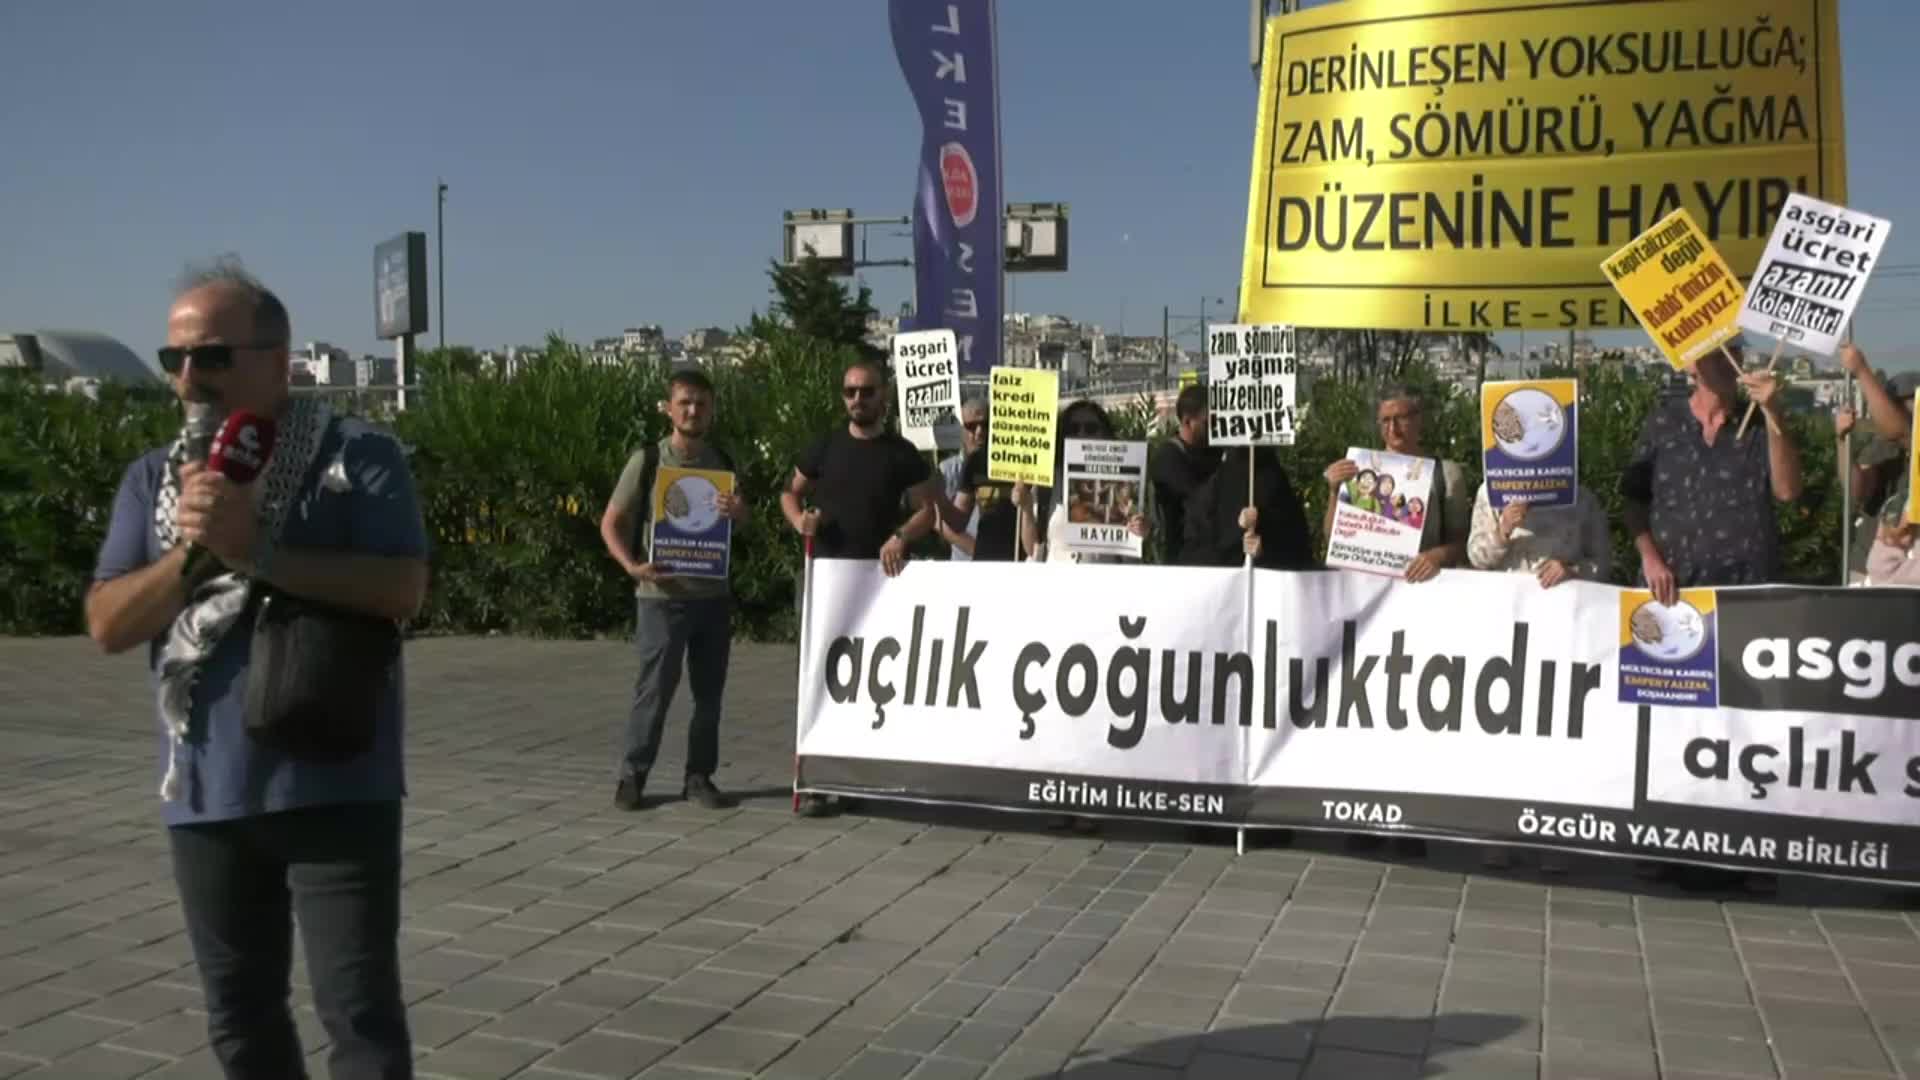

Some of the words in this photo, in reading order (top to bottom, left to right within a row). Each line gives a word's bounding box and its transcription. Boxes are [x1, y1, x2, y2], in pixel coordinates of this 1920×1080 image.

[1287, 41, 1507, 97] DERİNLEŞEN
[1522, 16, 1807, 79] YOKSULLUĞA;
[1280, 116, 1375, 167] ZAM,
[1389, 95, 1615, 157] SÖMÜRÜ,
[1634, 83, 1809, 148] YAĞMA
[1276, 174, 1574, 252] DÜZENİNE
[1786, 204, 1876, 243] asgari
[1608, 218, 1690, 280] kapitalizmin
[1661, 234, 1704, 274] değil
[1782, 228, 1871, 273] ücret
[1751, 287, 1843, 336] köleliktir!
[900, 337, 948, 359] asgari
[1211, 331, 1241, 357] zam,
[1244, 325, 1294, 354] sömürü
[905, 360, 953, 378] ücret
[993, 373, 1023, 387] faiz
[1225, 355, 1295, 380] yağma
[993, 389, 1035, 404] kredi
[1210, 379, 1283, 411] düzenine
[992, 406, 1050, 422] tüketim
[992, 421, 1047, 435] düzenine
[1210, 405, 1294, 440] hayır!
[991, 433, 1051, 450] kul-köle
[1080, 527, 1129, 542] HAYIR!
[826, 604, 988, 730] açlık
[1013, 615, 1601, 750] çoğunluktadır
[1683, 726, 1878, 800] açlık
[1028, 781, 1108, 808] EĞİTİM
[1116, 788, 1224, 815] İLKE-SEN
[1322, 800, 1403, 824] TOKAD
[1517, 808, 1617, 842] ÖZGÜR
[1627, 822, 1777, 861] YAZARLAR
[1787, 835, 1889, 870] BİRLİĞİ
